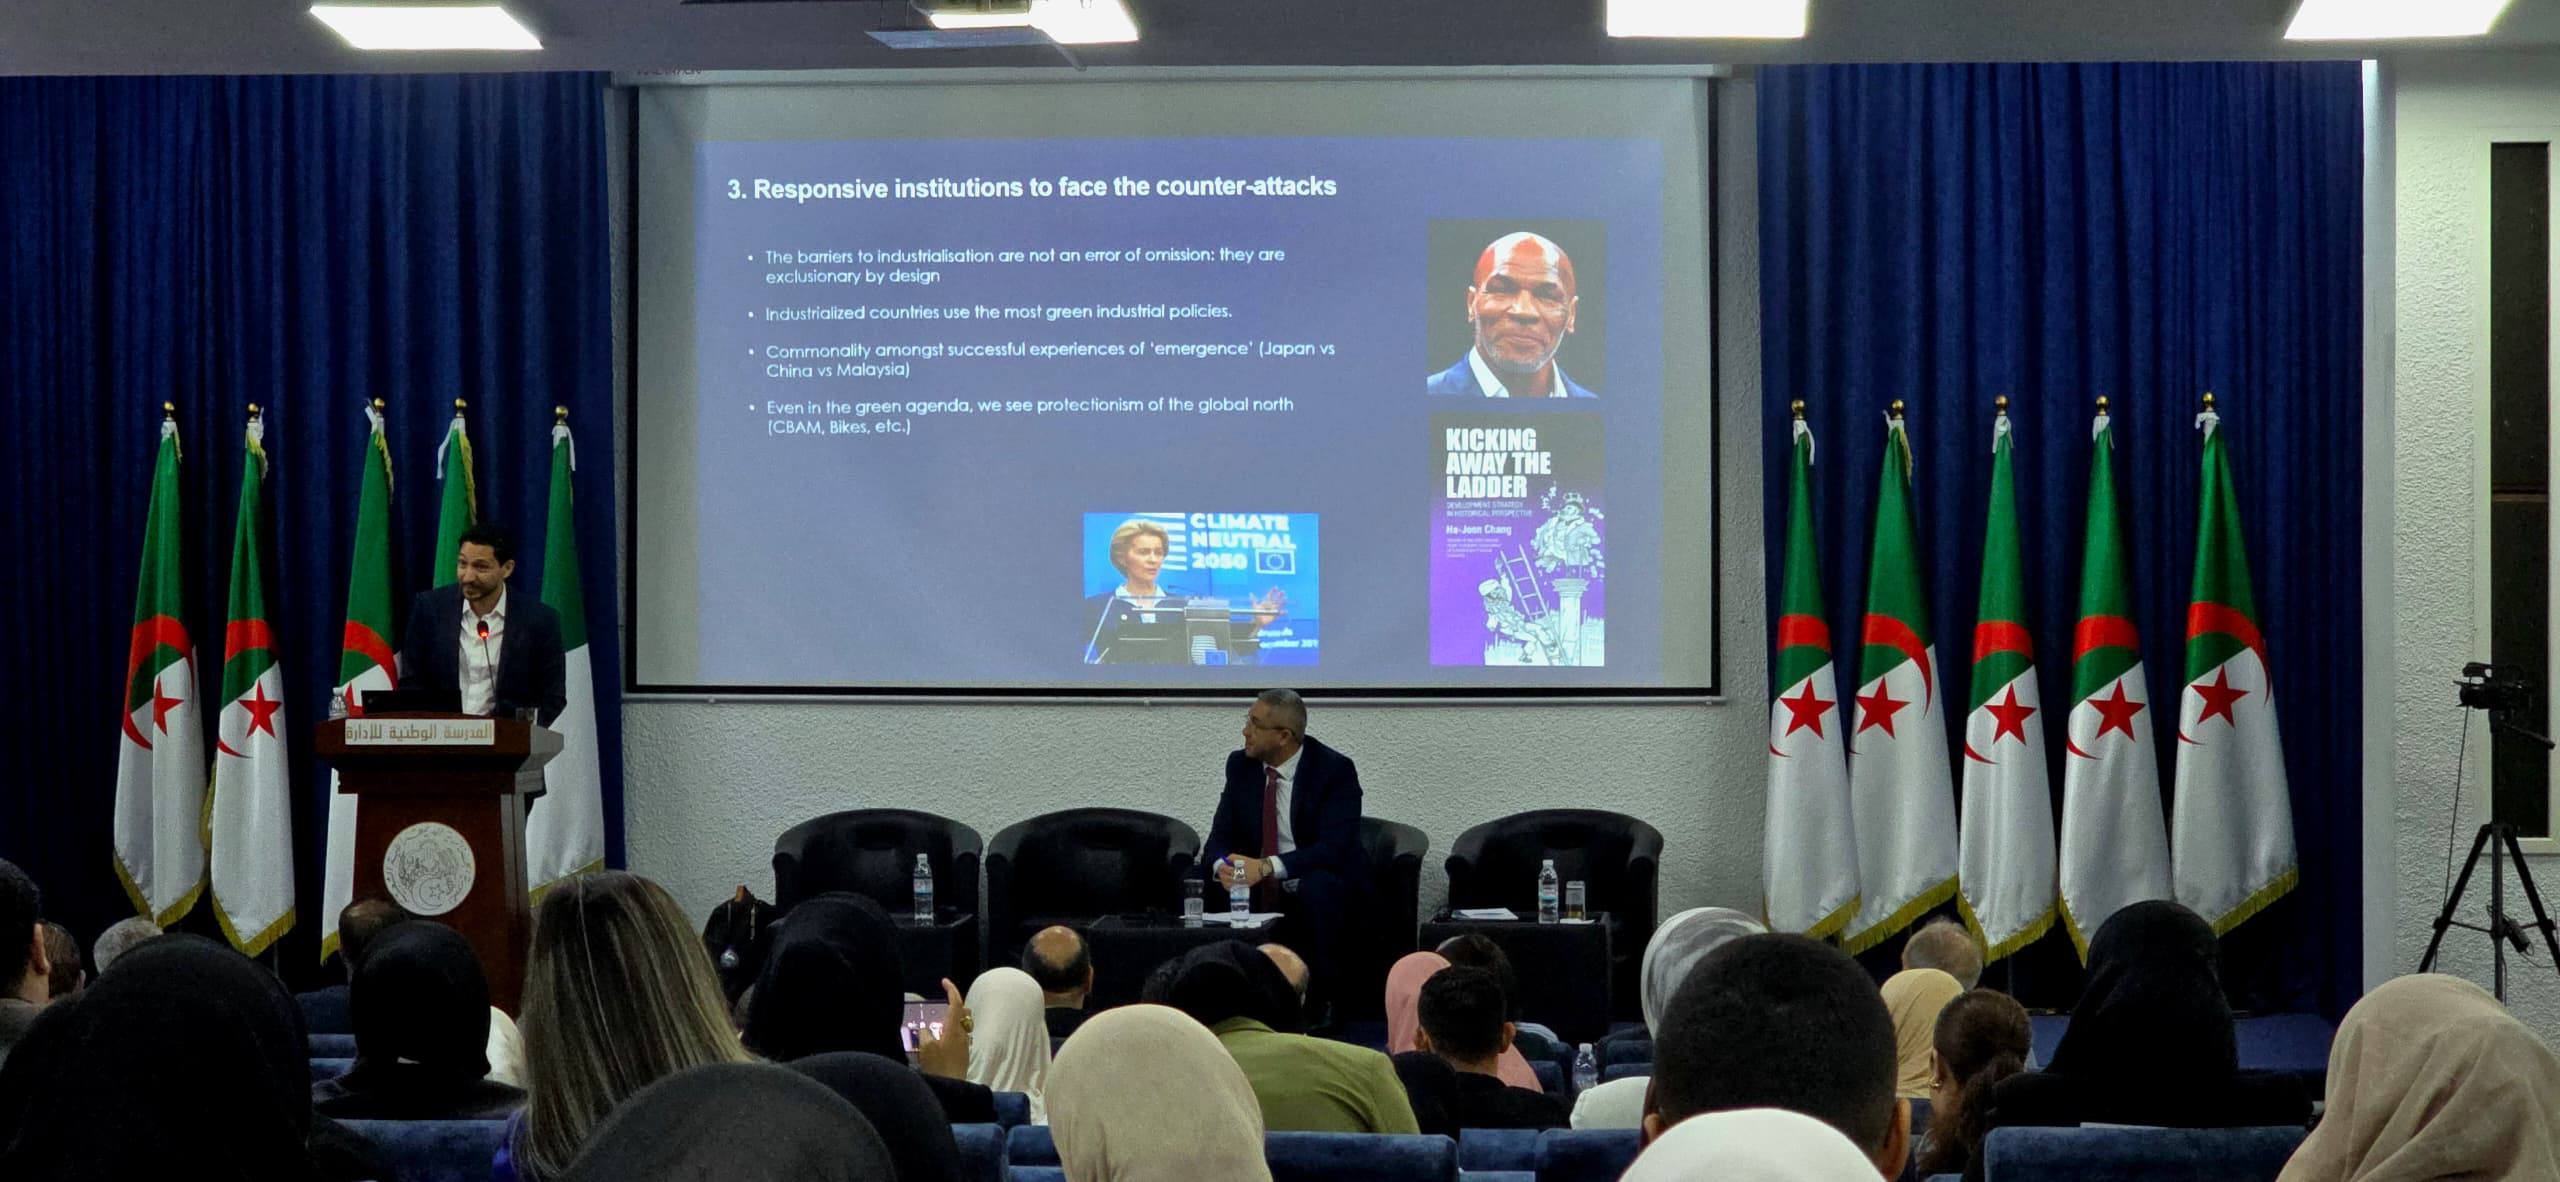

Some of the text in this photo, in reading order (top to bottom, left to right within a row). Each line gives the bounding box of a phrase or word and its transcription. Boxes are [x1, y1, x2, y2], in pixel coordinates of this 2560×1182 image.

[727, 175, 1338, 205] 3. Responsive institutions to face the counter-attacks
[766, 248, 1286, 265] The barriers to industrialisation are not an error of omission: they are
[765, 268, 941, 286] exclusionary by design
[765, 304, 1233, 322] Industrialized countries use the most green industrial policies.
[766, 342, 871, 362] Commonality
[875, 343, 944, 361] amongst
[948, 342, 1025, 358] successful
[1029, 343, 1125, 360] experiences
[1129, 341, 1146, 356] of
[1259, 341, 1316, 359] (Japan
[1319, 344, 1336, 356] vs
[766, 361, 911, 380] China vs Malaysia)
[767, 397, 1294, 417] Even in the green agenda, we see protectionism of the global north
[767, 416, 911, 437] (CBAM, Bikes, etc.)
[1446, 428, 1537, 452] KICKING
[1446, 451, 1552, 475] AWAY THE
[1446, 475, 1528, 499] LADDER
[1190, 513, 1290, 532] CLIMATE
[1484, 524, 1512, 537] Chang
[1191, 531, 1297, 550] NEUTRAL
[1191, 552, 1248, 570] 2050
[389, 722, 438, 742] الوطنية
[444, 722, 493, 741] المدرسة
